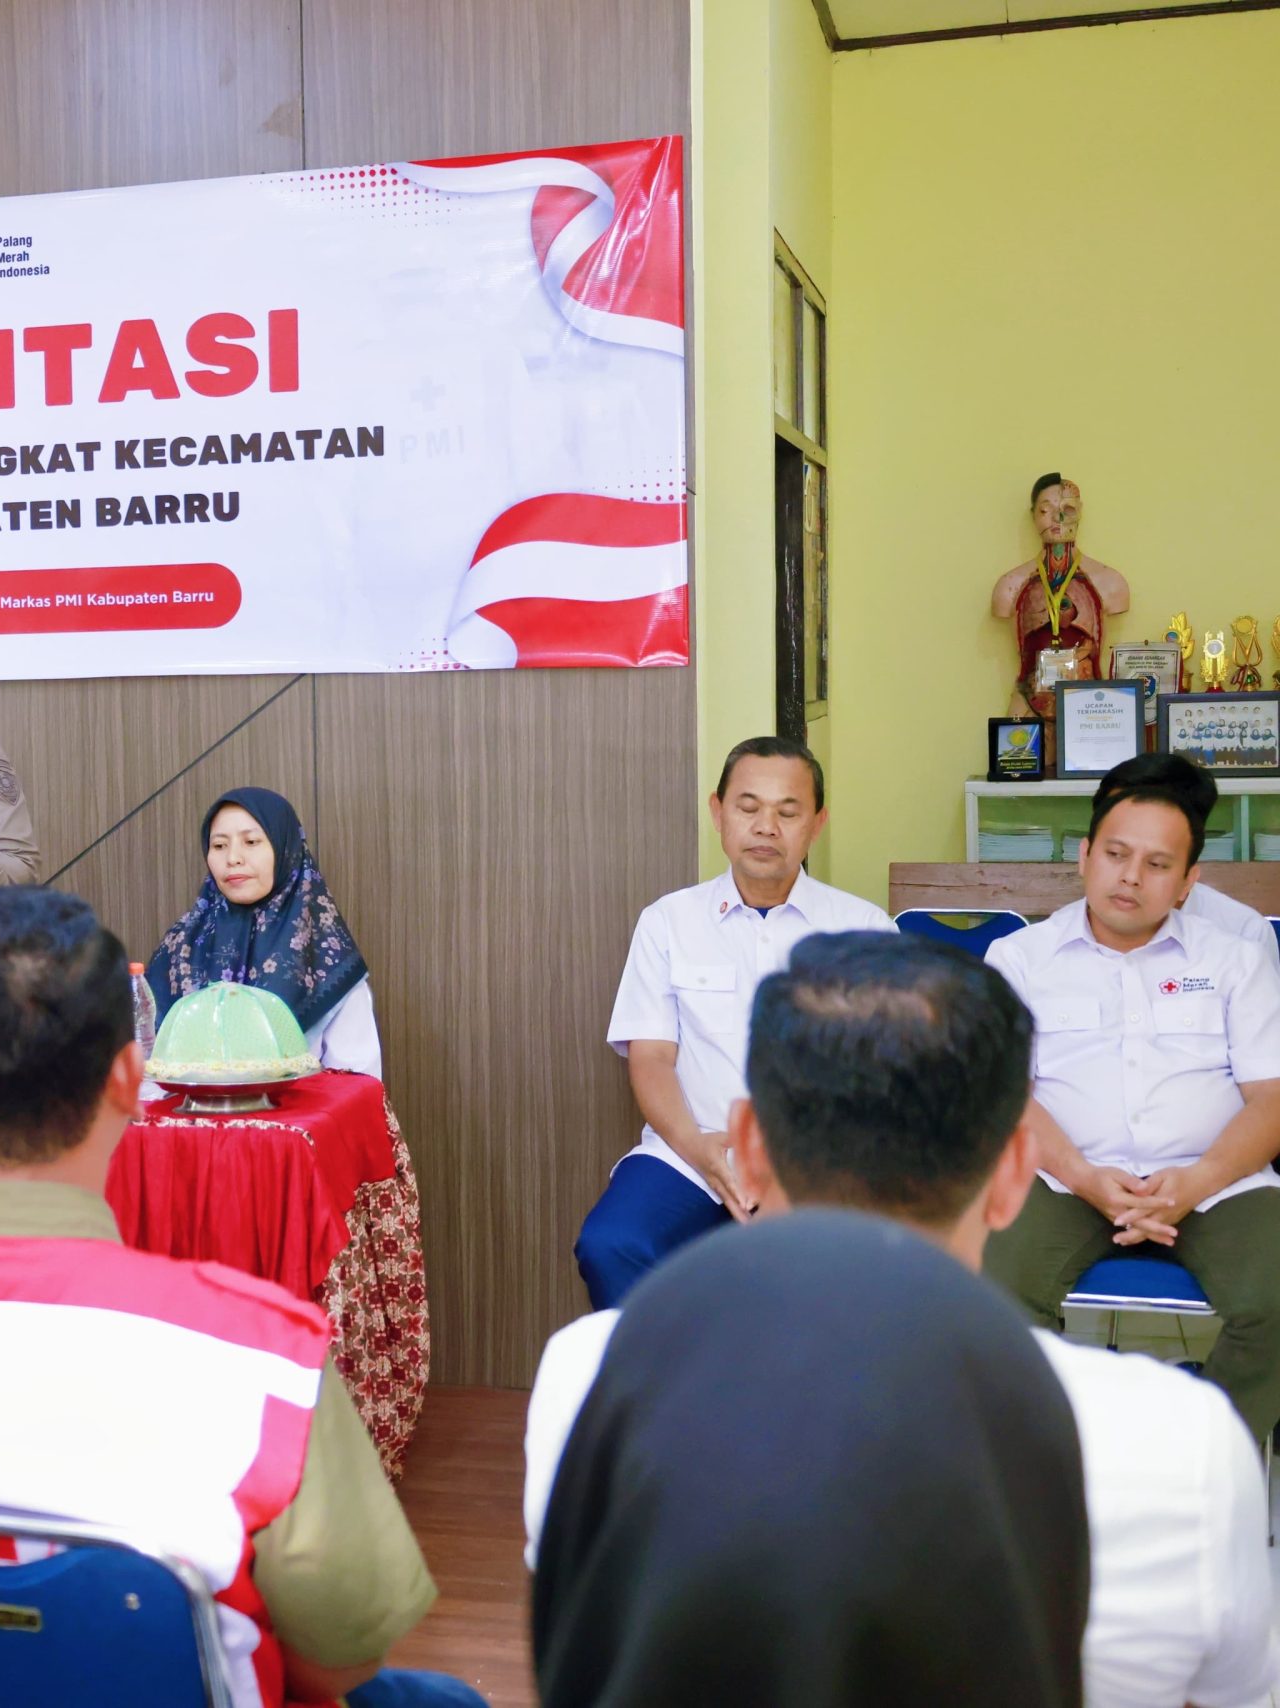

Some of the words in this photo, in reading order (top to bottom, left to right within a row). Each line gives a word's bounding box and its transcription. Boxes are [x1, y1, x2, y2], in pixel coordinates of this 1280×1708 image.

[114, 425, 385, 470] KECAMATAN
[95, 491, 240, 527] BARRU
[0, 595, 51, 609] Markas
[55, 594, 82, 607] PMI
[87, 592, 168, 607] Kabupaten
[172, 591, 214, 603] Barru
